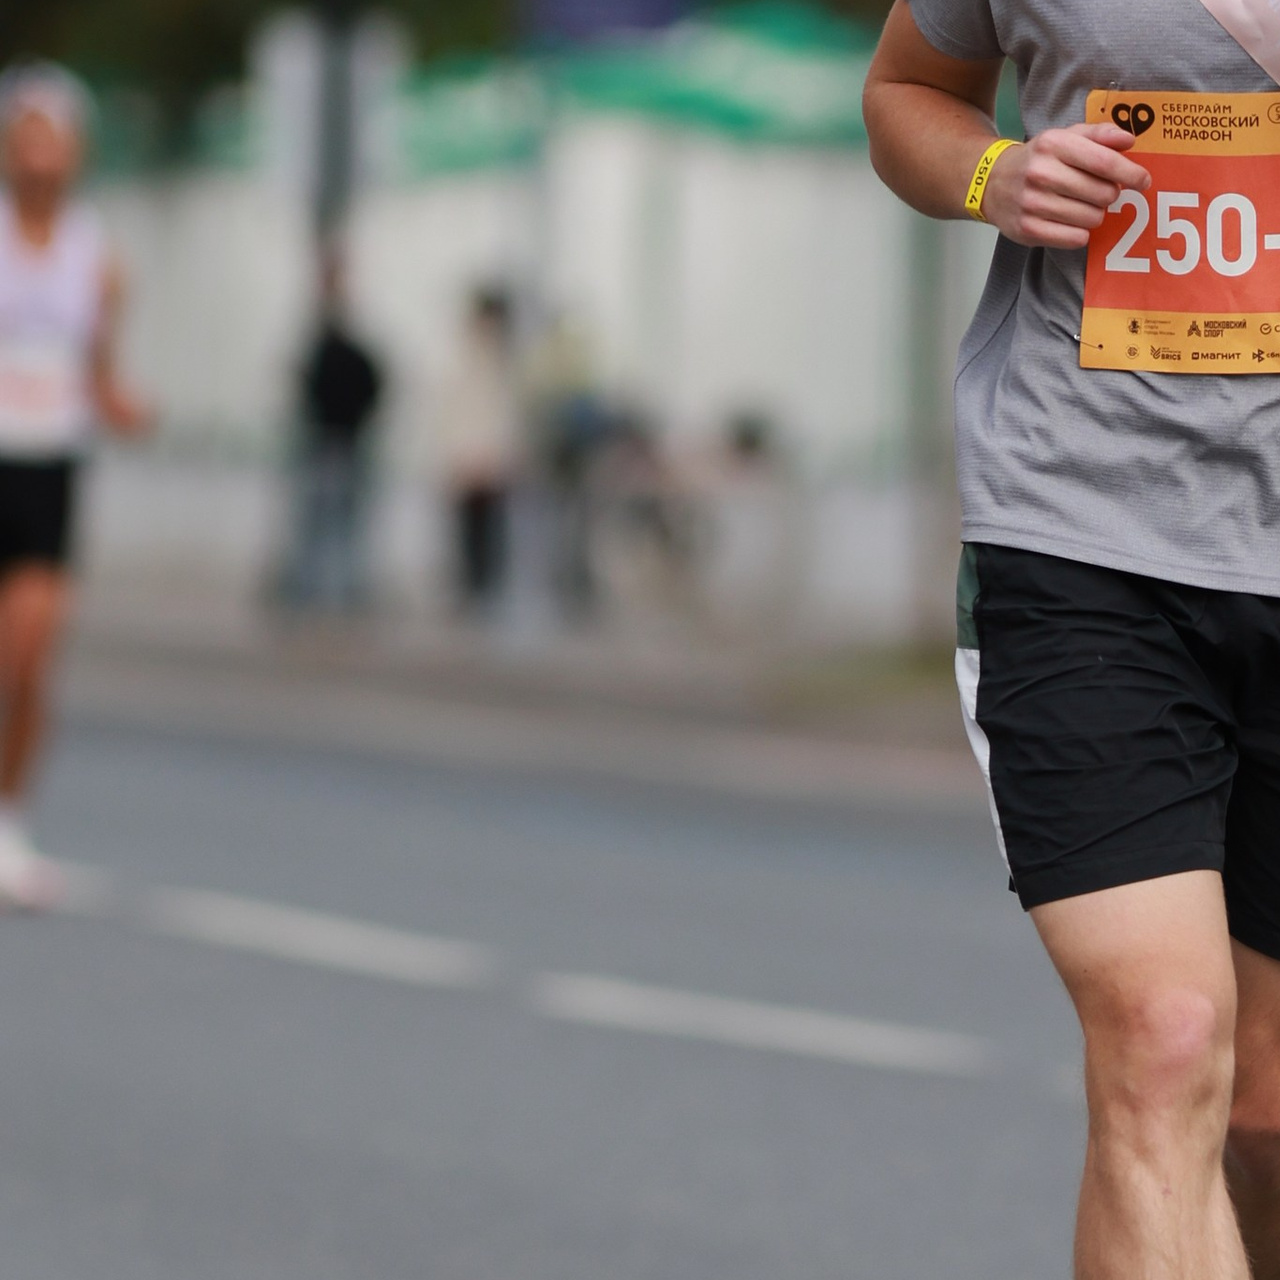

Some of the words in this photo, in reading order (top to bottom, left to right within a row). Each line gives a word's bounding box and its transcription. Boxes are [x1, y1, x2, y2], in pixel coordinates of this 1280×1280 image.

[1161, 103, 1232, 114] СБЕРПРАЙМ
[1162, 114, 1260, 128] МОСКОВСКИЙ
[1163, 128, 1232, 141] МАРАФОН
[968, 156, 993, 204] 250-4
[1204, 319, 1247, 329] МОСКОВСКИЙ
[1204, 329, 1224, 338] СПОРТ
[1161, 353, 1181, 361] BRICS
